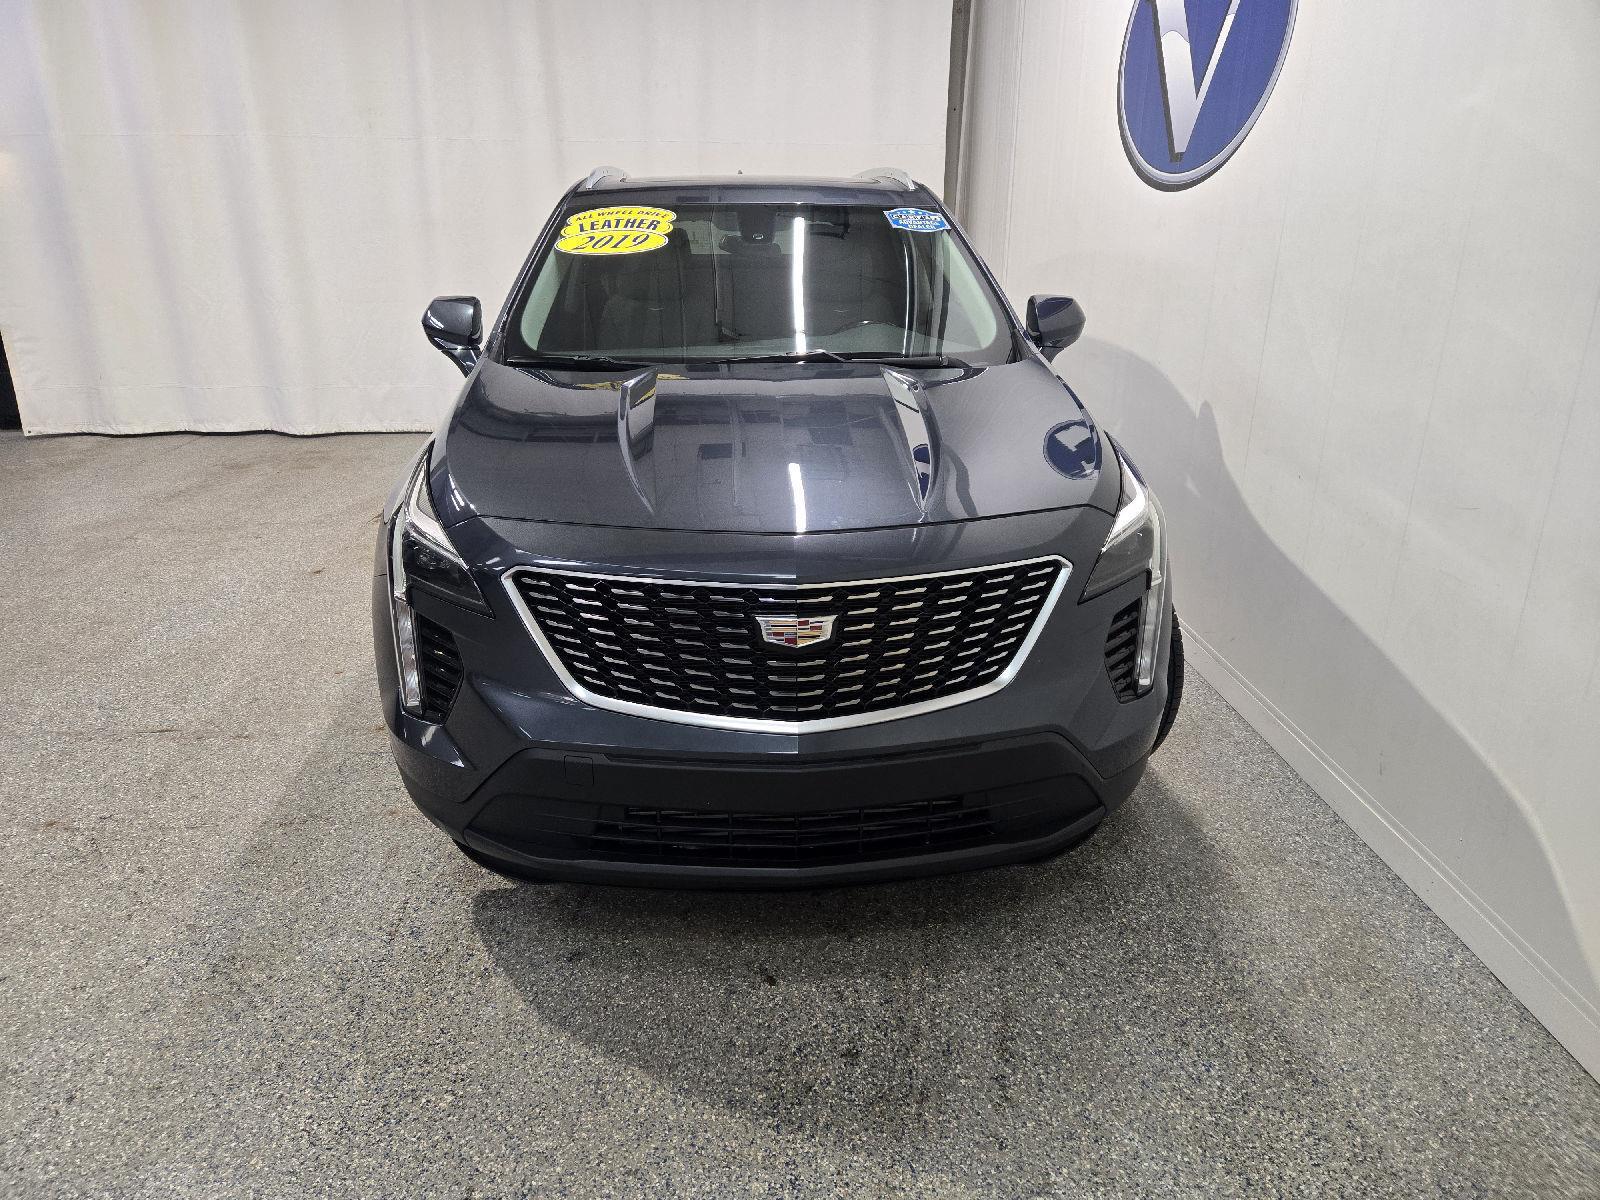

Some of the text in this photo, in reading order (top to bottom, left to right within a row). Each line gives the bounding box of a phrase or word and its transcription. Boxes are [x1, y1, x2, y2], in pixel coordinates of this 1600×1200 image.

[575, 213, 593, 222] ALL
[637, 210, 669, 219] DRIVE
[579, 218, 661, 232] LEATHER
[571, 234, 650, 250] 2019
